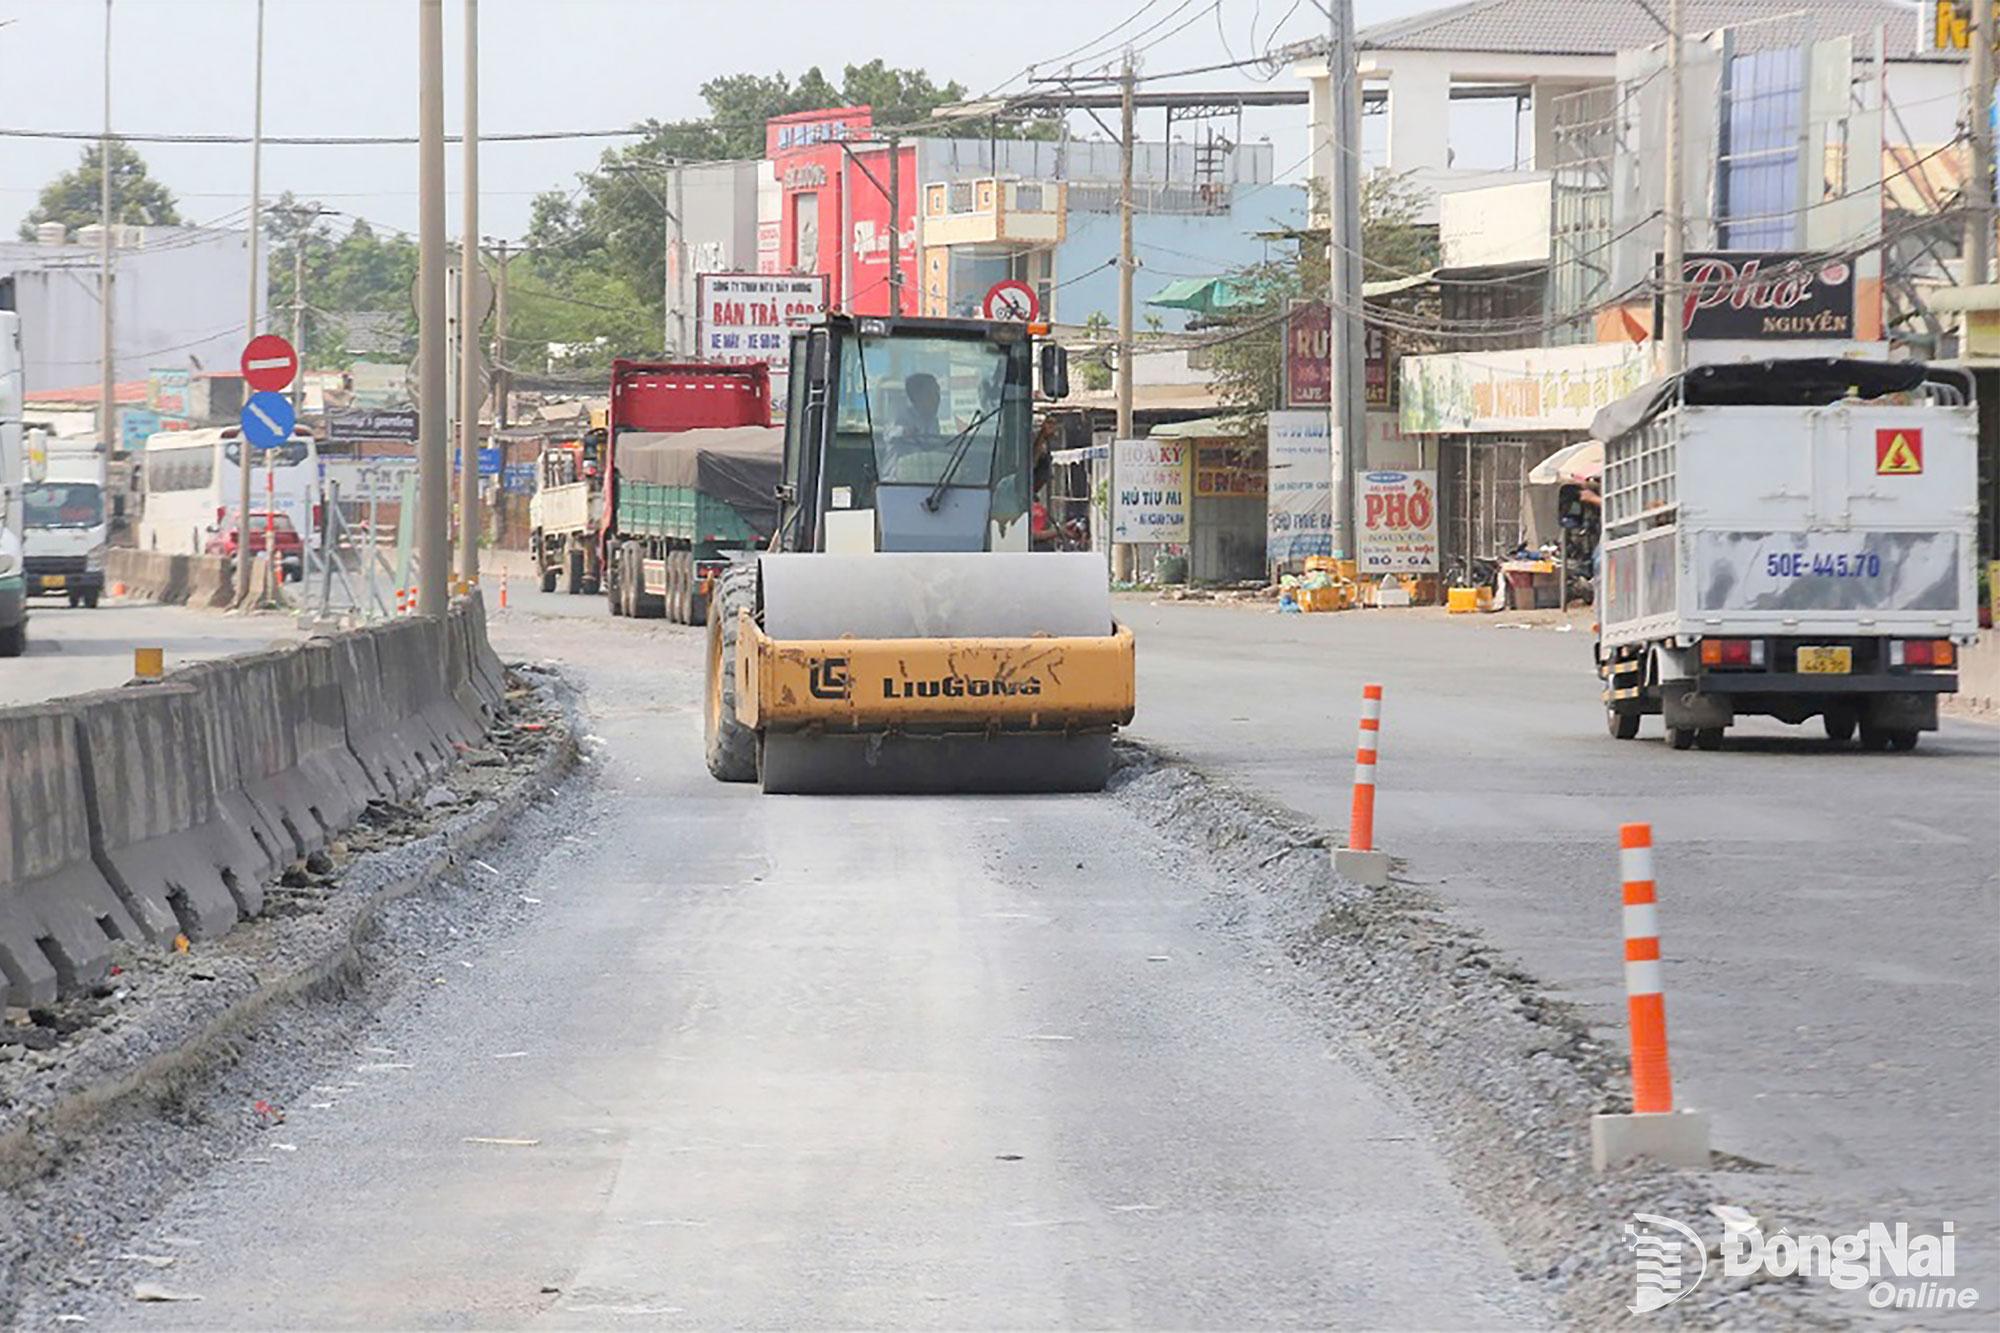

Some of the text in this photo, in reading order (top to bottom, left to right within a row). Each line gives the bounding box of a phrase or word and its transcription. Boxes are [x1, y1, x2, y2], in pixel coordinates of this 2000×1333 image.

[713, 298, 745, 327] BÁN
[750, 296, 779, 327] TRẢ
[1364, 479, 1432, 529] PHỞ
[1767, 553, 1880, 578] 50E-445.70
